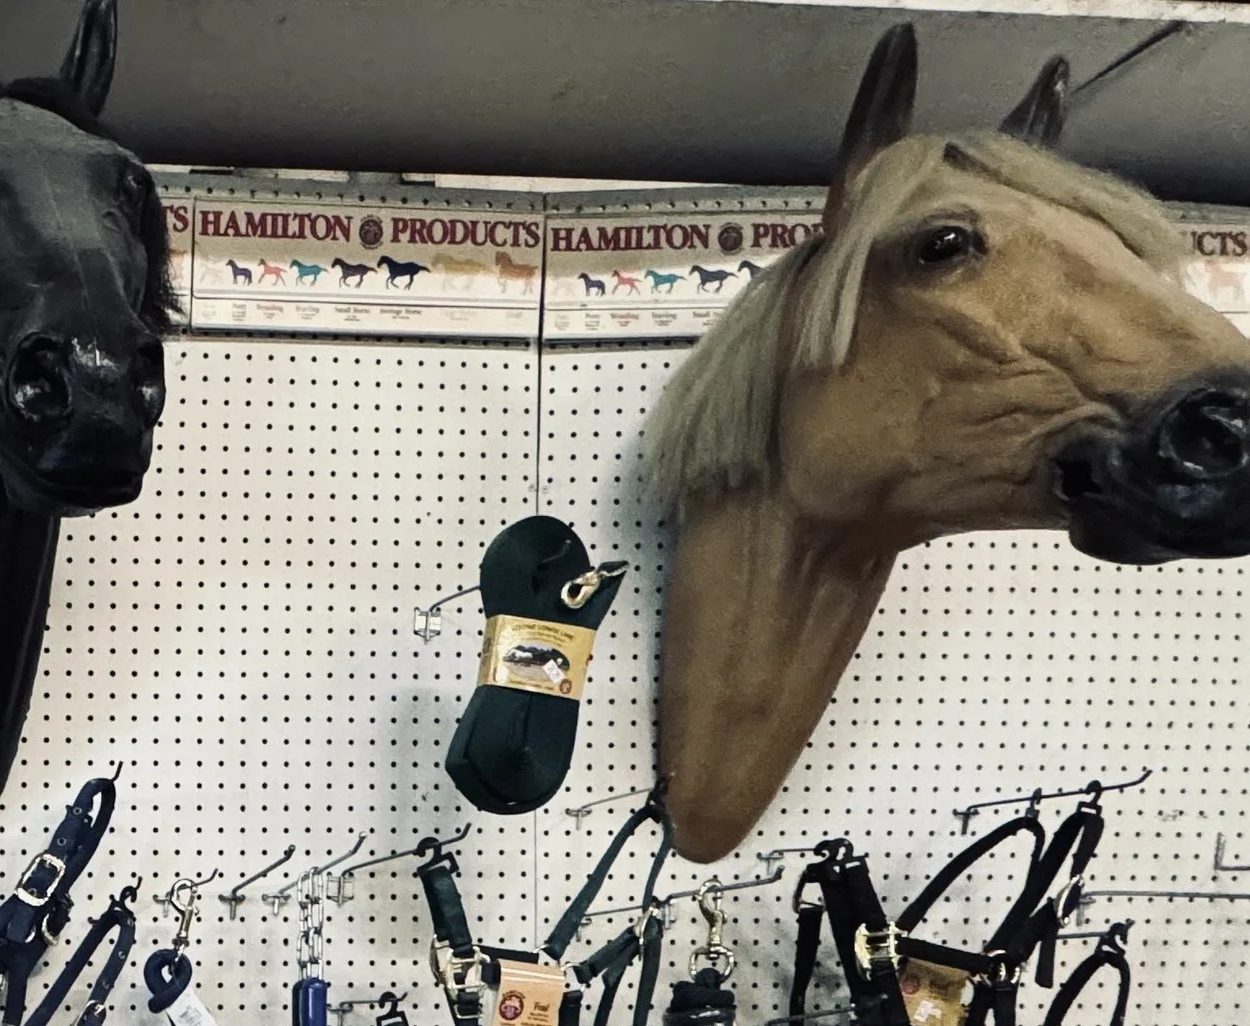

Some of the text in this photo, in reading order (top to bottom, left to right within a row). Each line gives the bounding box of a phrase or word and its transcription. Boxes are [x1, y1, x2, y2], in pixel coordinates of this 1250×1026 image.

[199, 210, 353, 243] HAMILTON
[391, 216, 540, 249] PRODUCTS
[551, 222, 711, 251] HAMILTON
